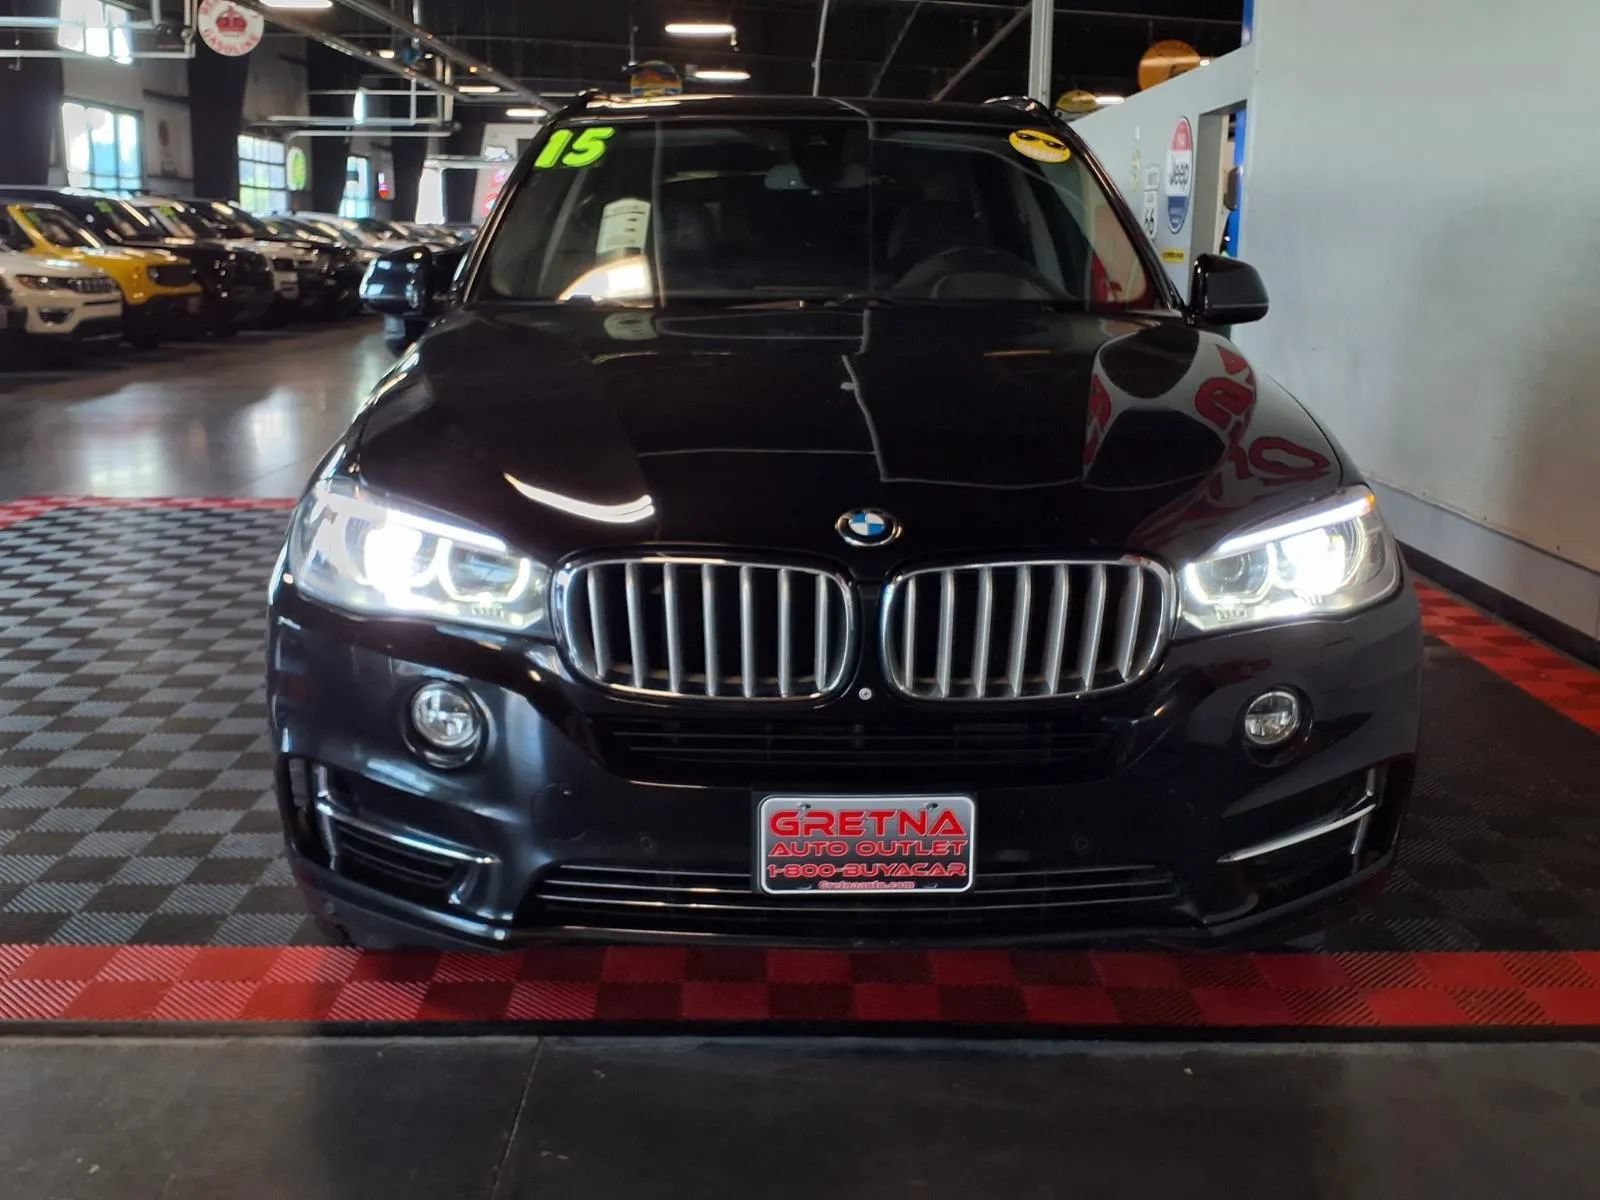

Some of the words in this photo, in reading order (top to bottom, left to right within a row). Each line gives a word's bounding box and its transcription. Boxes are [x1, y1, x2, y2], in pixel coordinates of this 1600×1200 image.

[534, 127, 615, 168] 15
[1169, 161, 1190, 190] Jeep
[769, 809, 967, 838] GRETNA
[768, 840, 849, 857] AUTO
[855, 840, 968, 857] OUTLET
[767, 862, 967, 878] 1-800-BUYACAR
